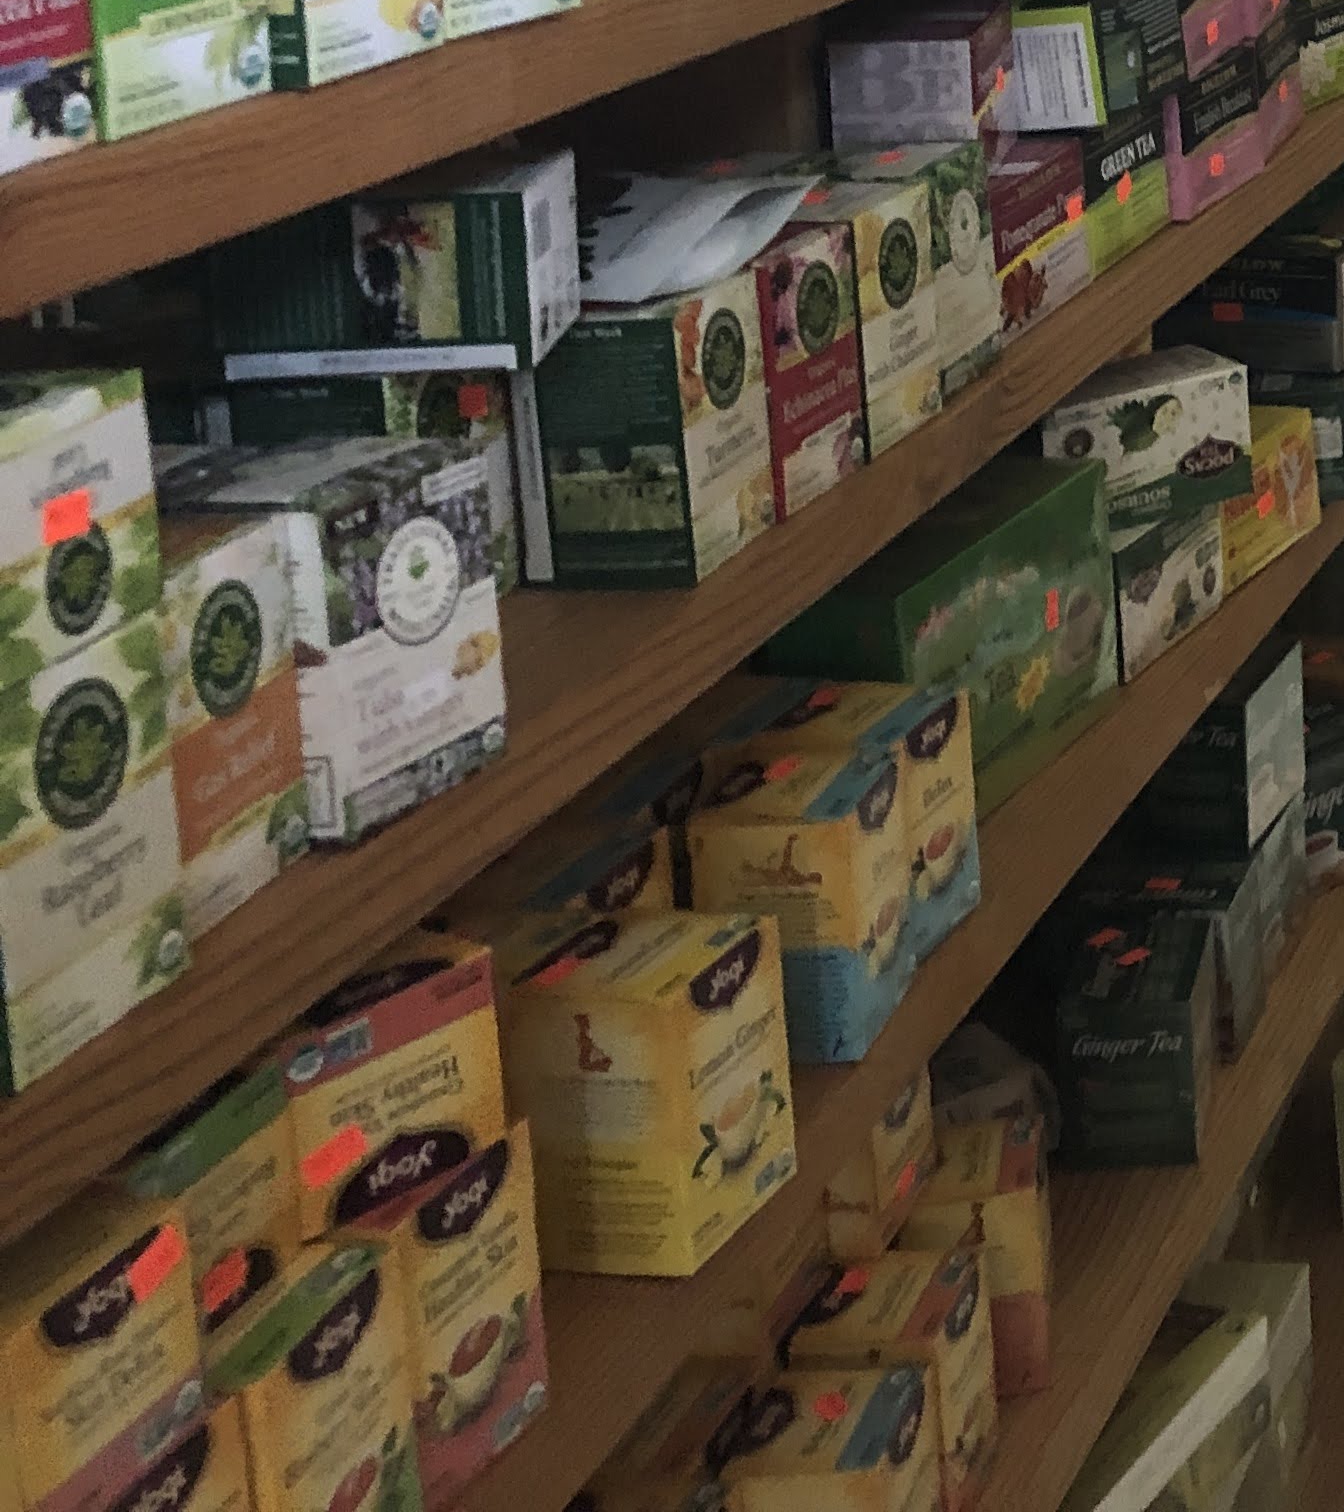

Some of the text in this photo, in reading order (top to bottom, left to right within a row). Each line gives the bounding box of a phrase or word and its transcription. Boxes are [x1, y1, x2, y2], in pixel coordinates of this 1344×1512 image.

[1100, 131, 1157, 181] GREEN TEA
[1073, 1029, 1184, 1060] Ginger Tea
